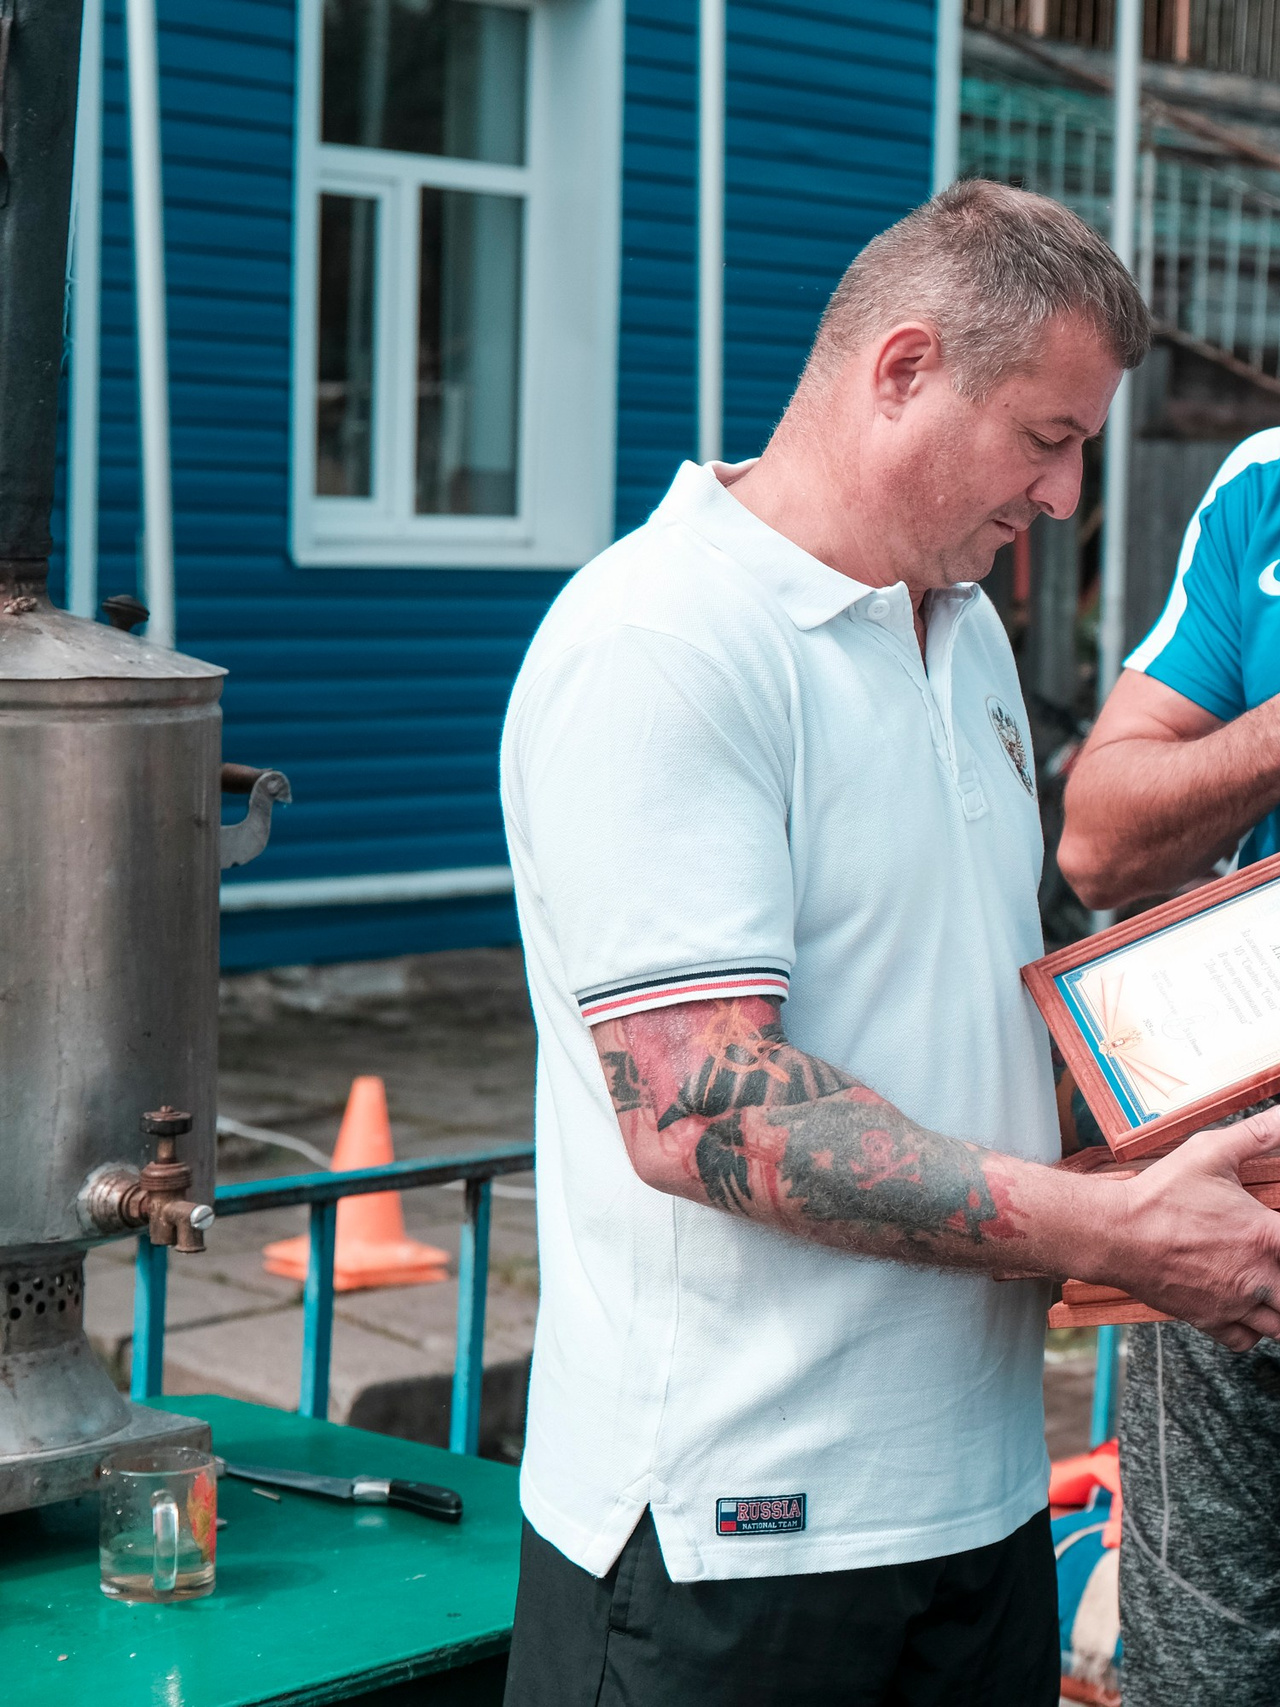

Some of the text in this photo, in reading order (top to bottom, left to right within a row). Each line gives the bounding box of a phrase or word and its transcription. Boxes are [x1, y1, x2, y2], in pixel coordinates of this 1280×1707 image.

[737, 1499, 801, 1521] RUSSIA
[742, 1520, 798, 1530] NATIONAL TEAM
